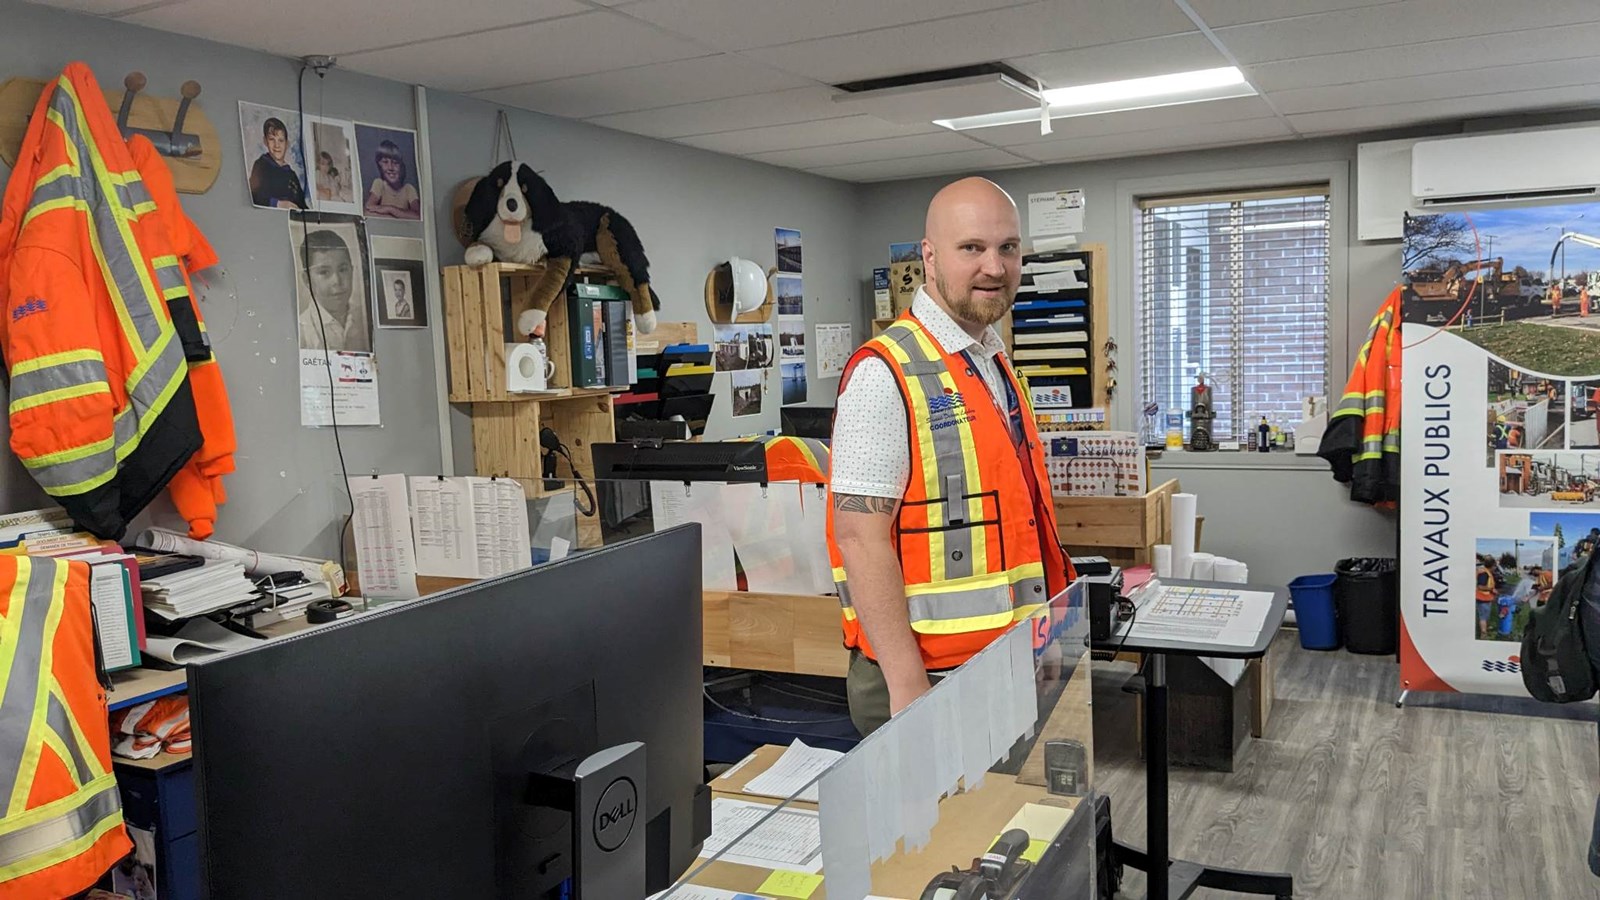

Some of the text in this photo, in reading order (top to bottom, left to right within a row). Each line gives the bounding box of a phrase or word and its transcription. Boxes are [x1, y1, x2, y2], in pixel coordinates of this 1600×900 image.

[929, 415, 976, 431] COORDONATEUR
[1423, 364, 1452, 618] TRAVAUX PUBLICS
[600, 798, 634, 832] DELL
